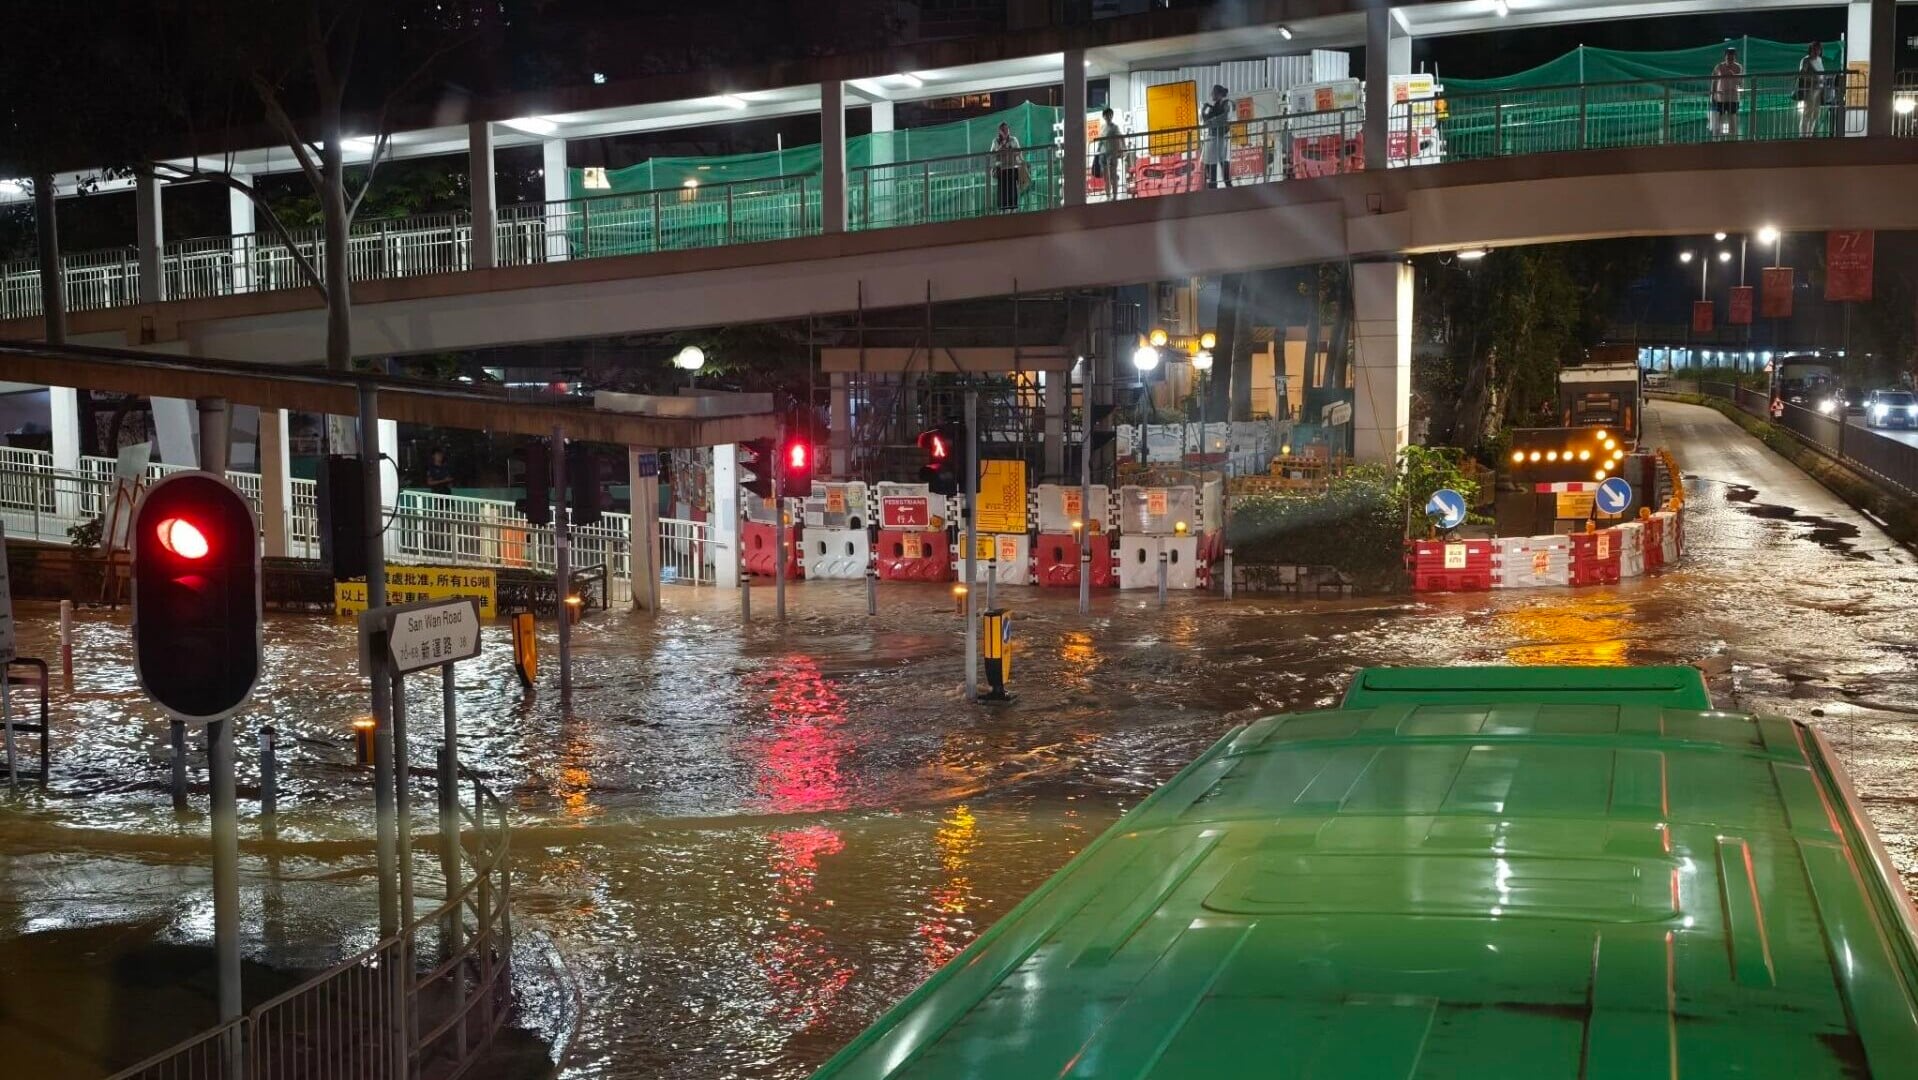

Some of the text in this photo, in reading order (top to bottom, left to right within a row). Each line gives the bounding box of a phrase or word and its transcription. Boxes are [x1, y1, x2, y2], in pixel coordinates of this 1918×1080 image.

[1839, 231, 1862, 252] 77
[897, 514, 916, 524] 行人
[408, 609, 462, 632] San Wan Road
[421, 636, 452, 659] 新運路
